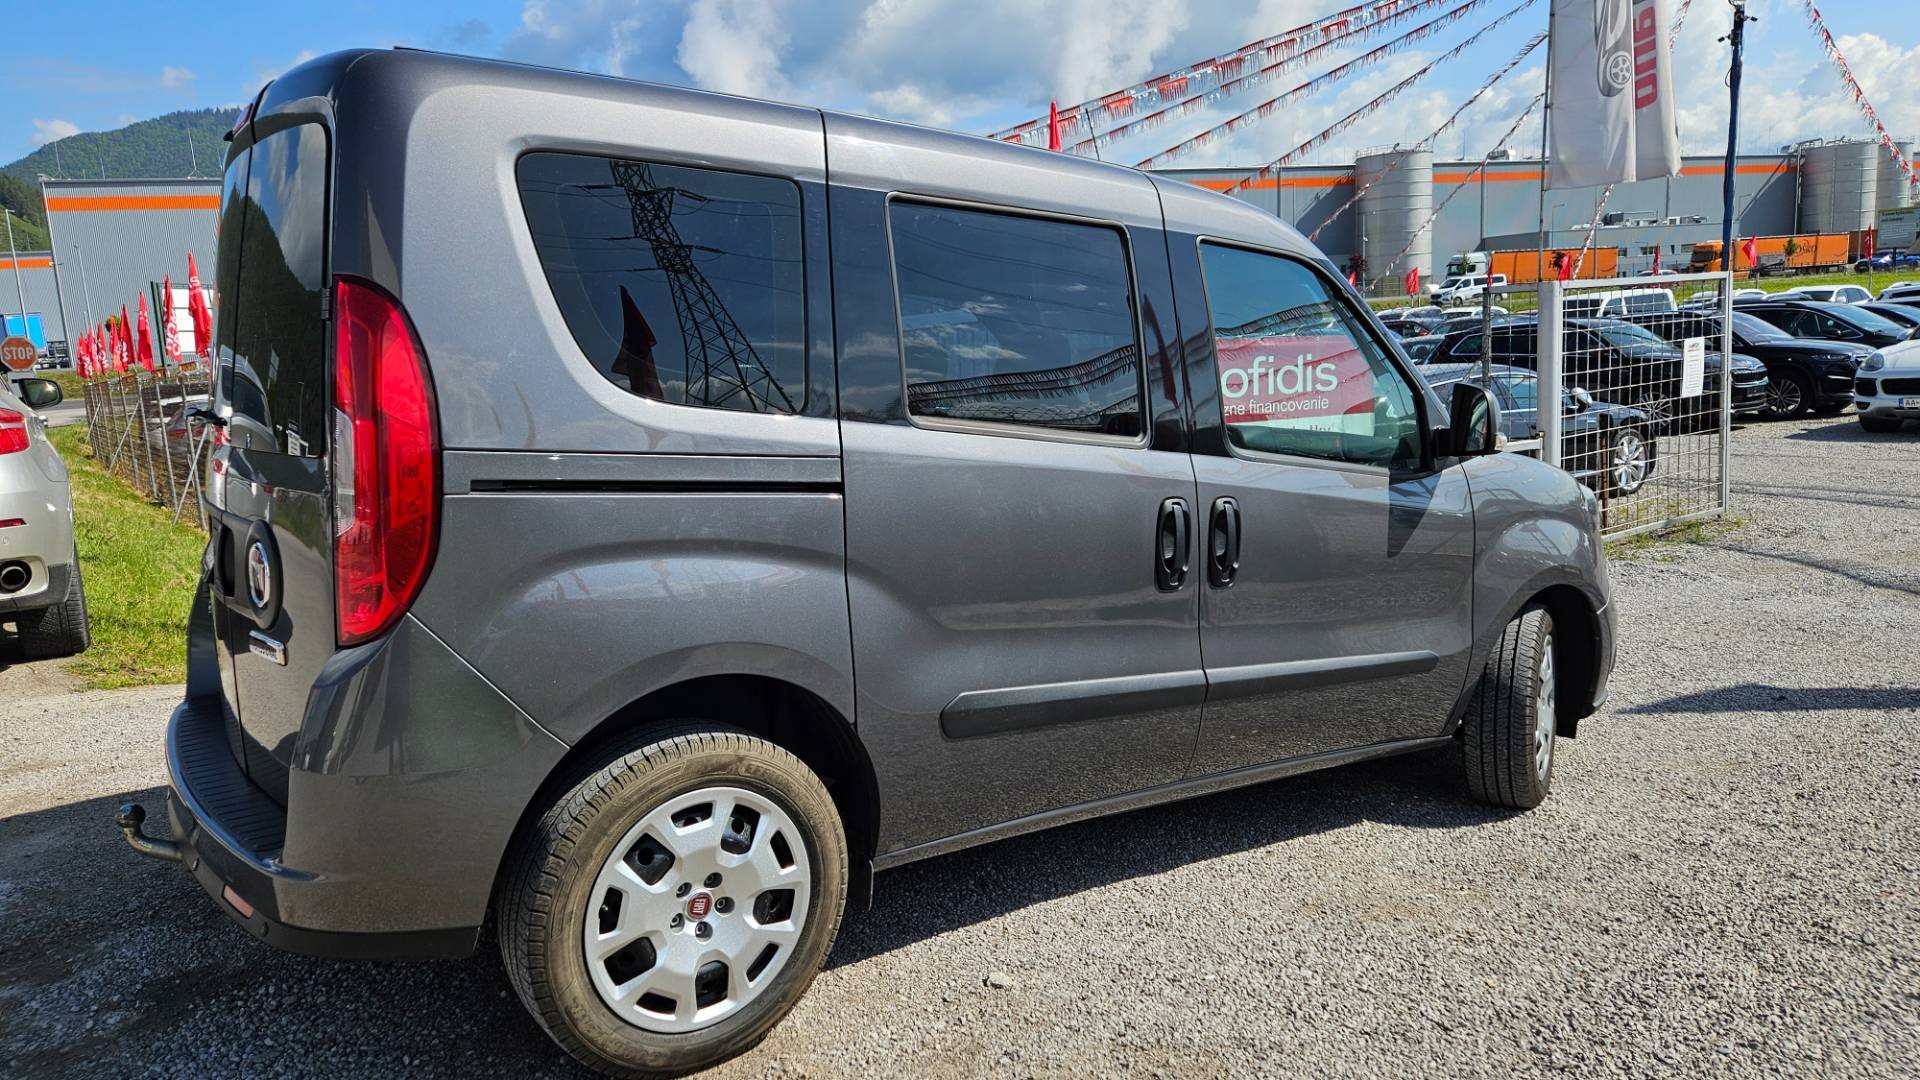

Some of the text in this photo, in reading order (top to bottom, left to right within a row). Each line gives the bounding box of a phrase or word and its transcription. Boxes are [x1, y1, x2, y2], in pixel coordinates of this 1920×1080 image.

[3, 346, 34, 361] STOP
[1221, 354, 1338, 398] ofidis
[1249, 397, 1329, 414] financovanie
[692, 899, 706, 914] FIAT
